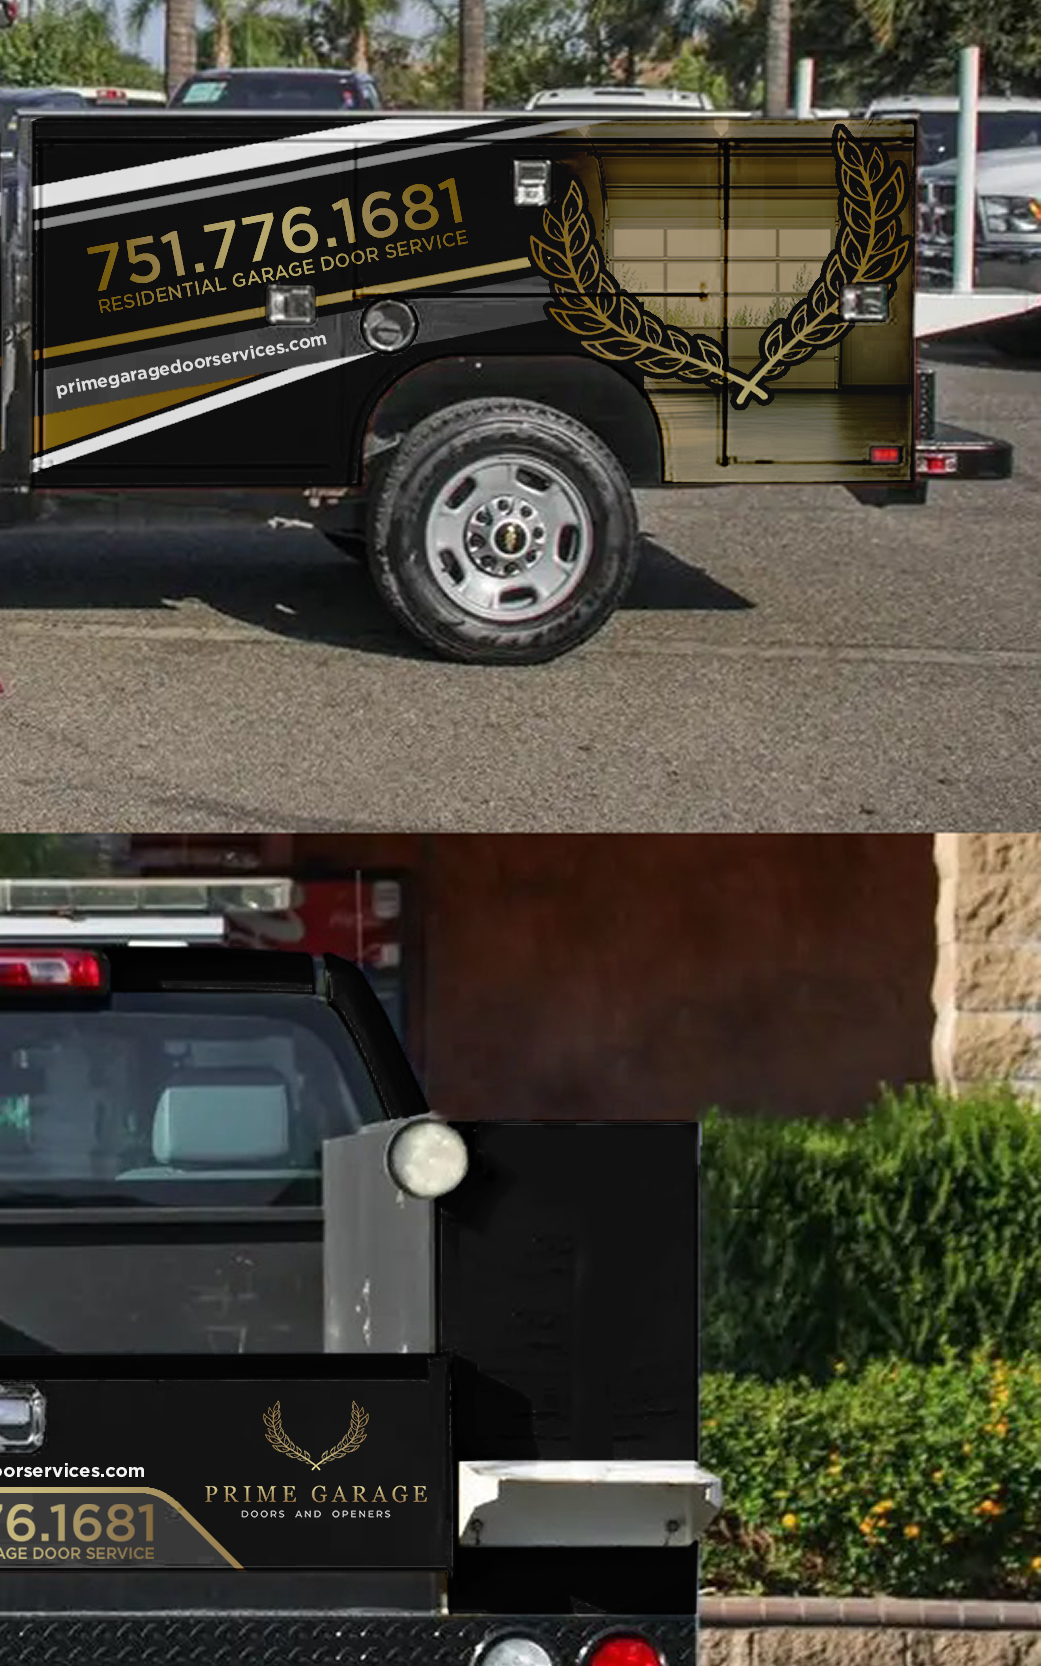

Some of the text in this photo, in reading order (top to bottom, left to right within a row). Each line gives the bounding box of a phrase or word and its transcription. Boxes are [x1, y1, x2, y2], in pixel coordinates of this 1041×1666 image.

[87, 178, 464, 292] 751.776.1681
[98, 230, 468, 314] RESIDENTIAL GARAGE DOOR SERVICE
[56, 332, 327, 399] primegaragedoorservices.com
[205, 1485, 427, 1502] PRIME GARAGE
[242, 1510, 390, 1518] DOORS AND OPENERS
[33, 1547, 80, 1559] DOOR
[86, 1547, 154, 1559] SERVICE
